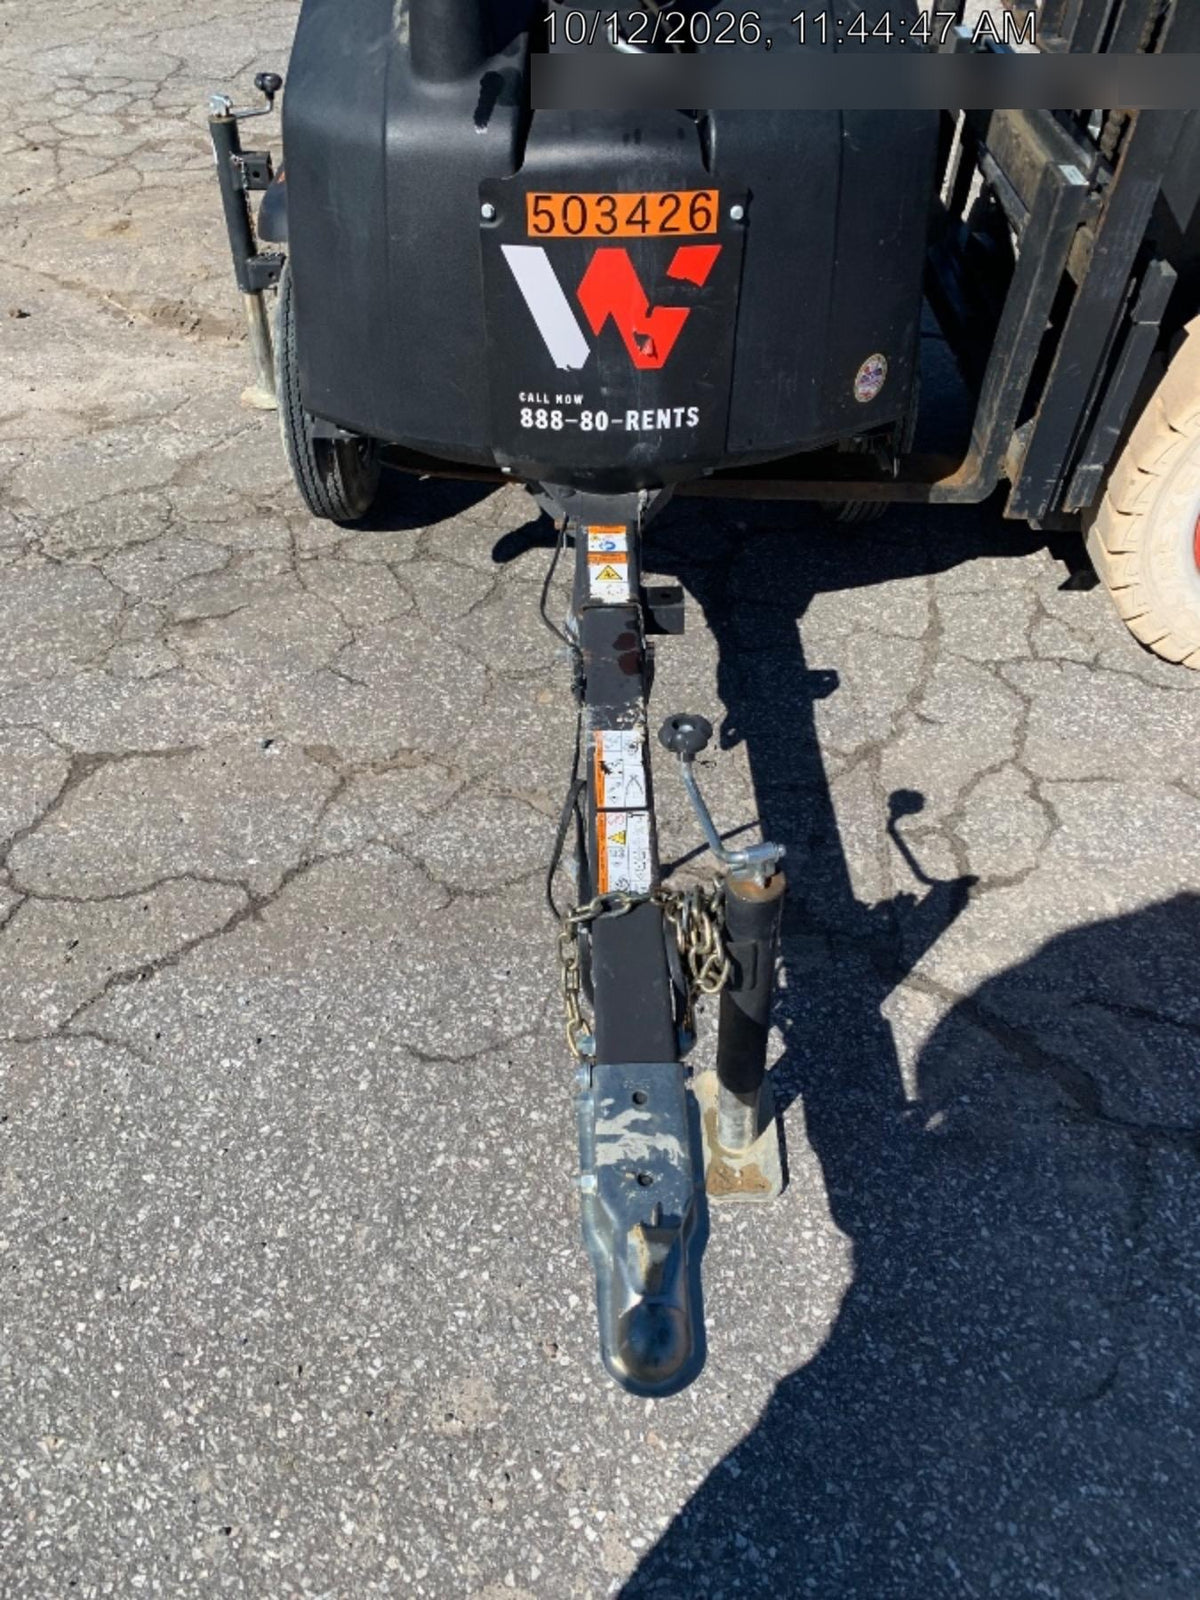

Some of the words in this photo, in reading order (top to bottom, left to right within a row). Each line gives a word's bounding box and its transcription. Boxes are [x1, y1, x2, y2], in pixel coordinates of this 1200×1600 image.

[531, 191, 713, 236] 503426
[518, 391, 550, 405] CALL
[555, 393, 585, 405] NOW
[519, 406, 701, 432] 888-80-RENTS
